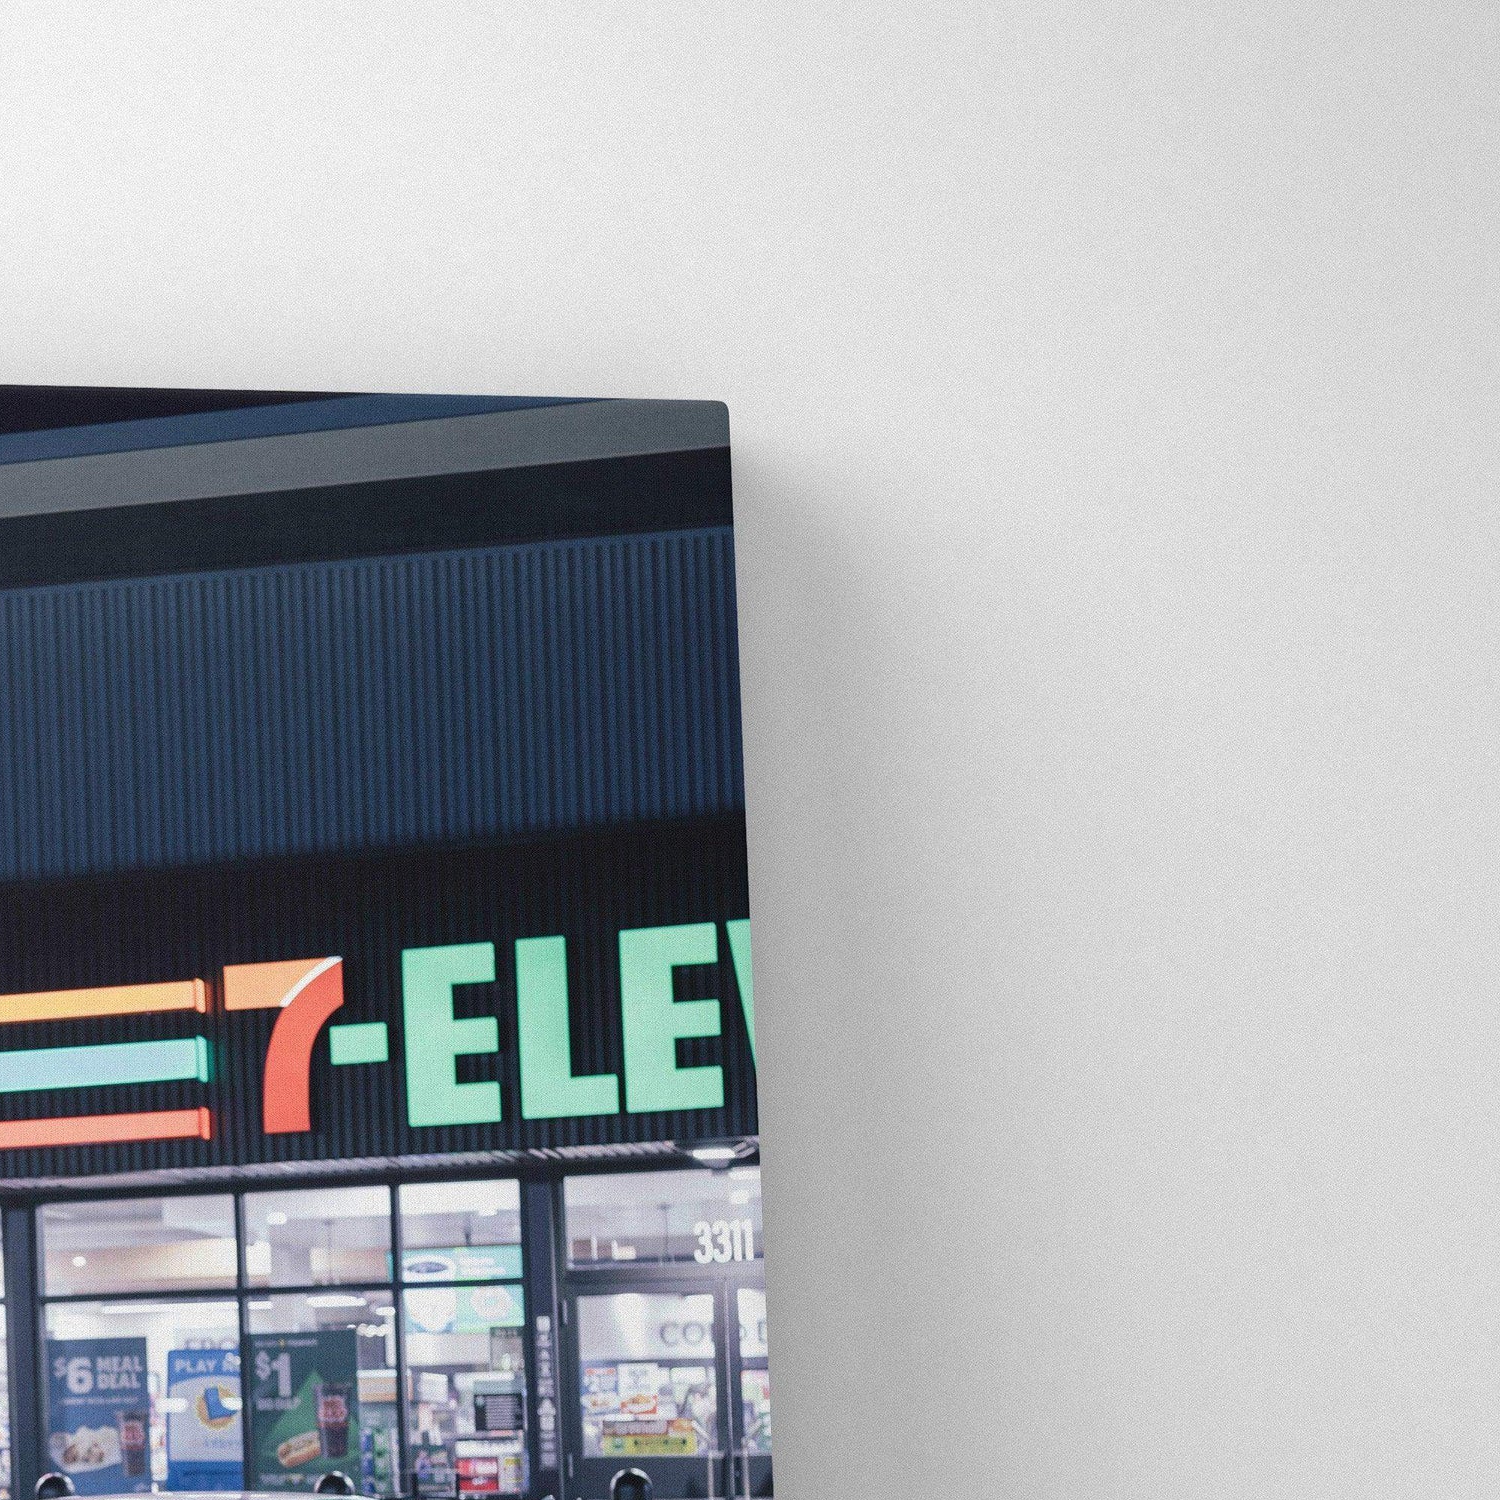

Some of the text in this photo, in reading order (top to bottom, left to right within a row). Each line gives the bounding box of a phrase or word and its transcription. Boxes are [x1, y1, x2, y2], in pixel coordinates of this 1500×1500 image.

[223, 918, 757, 1134] 7-ELE
[692, 1218, 754, 1264] 3311
[54, 1356, 95, 1395] $6
[97, 1356, 143, 1373] MEAL
[97, 1372, 141, 1390] DEAL
[174, 1358, 217, 1373] PLAY
[255, 1350, 292, 1397] $1
